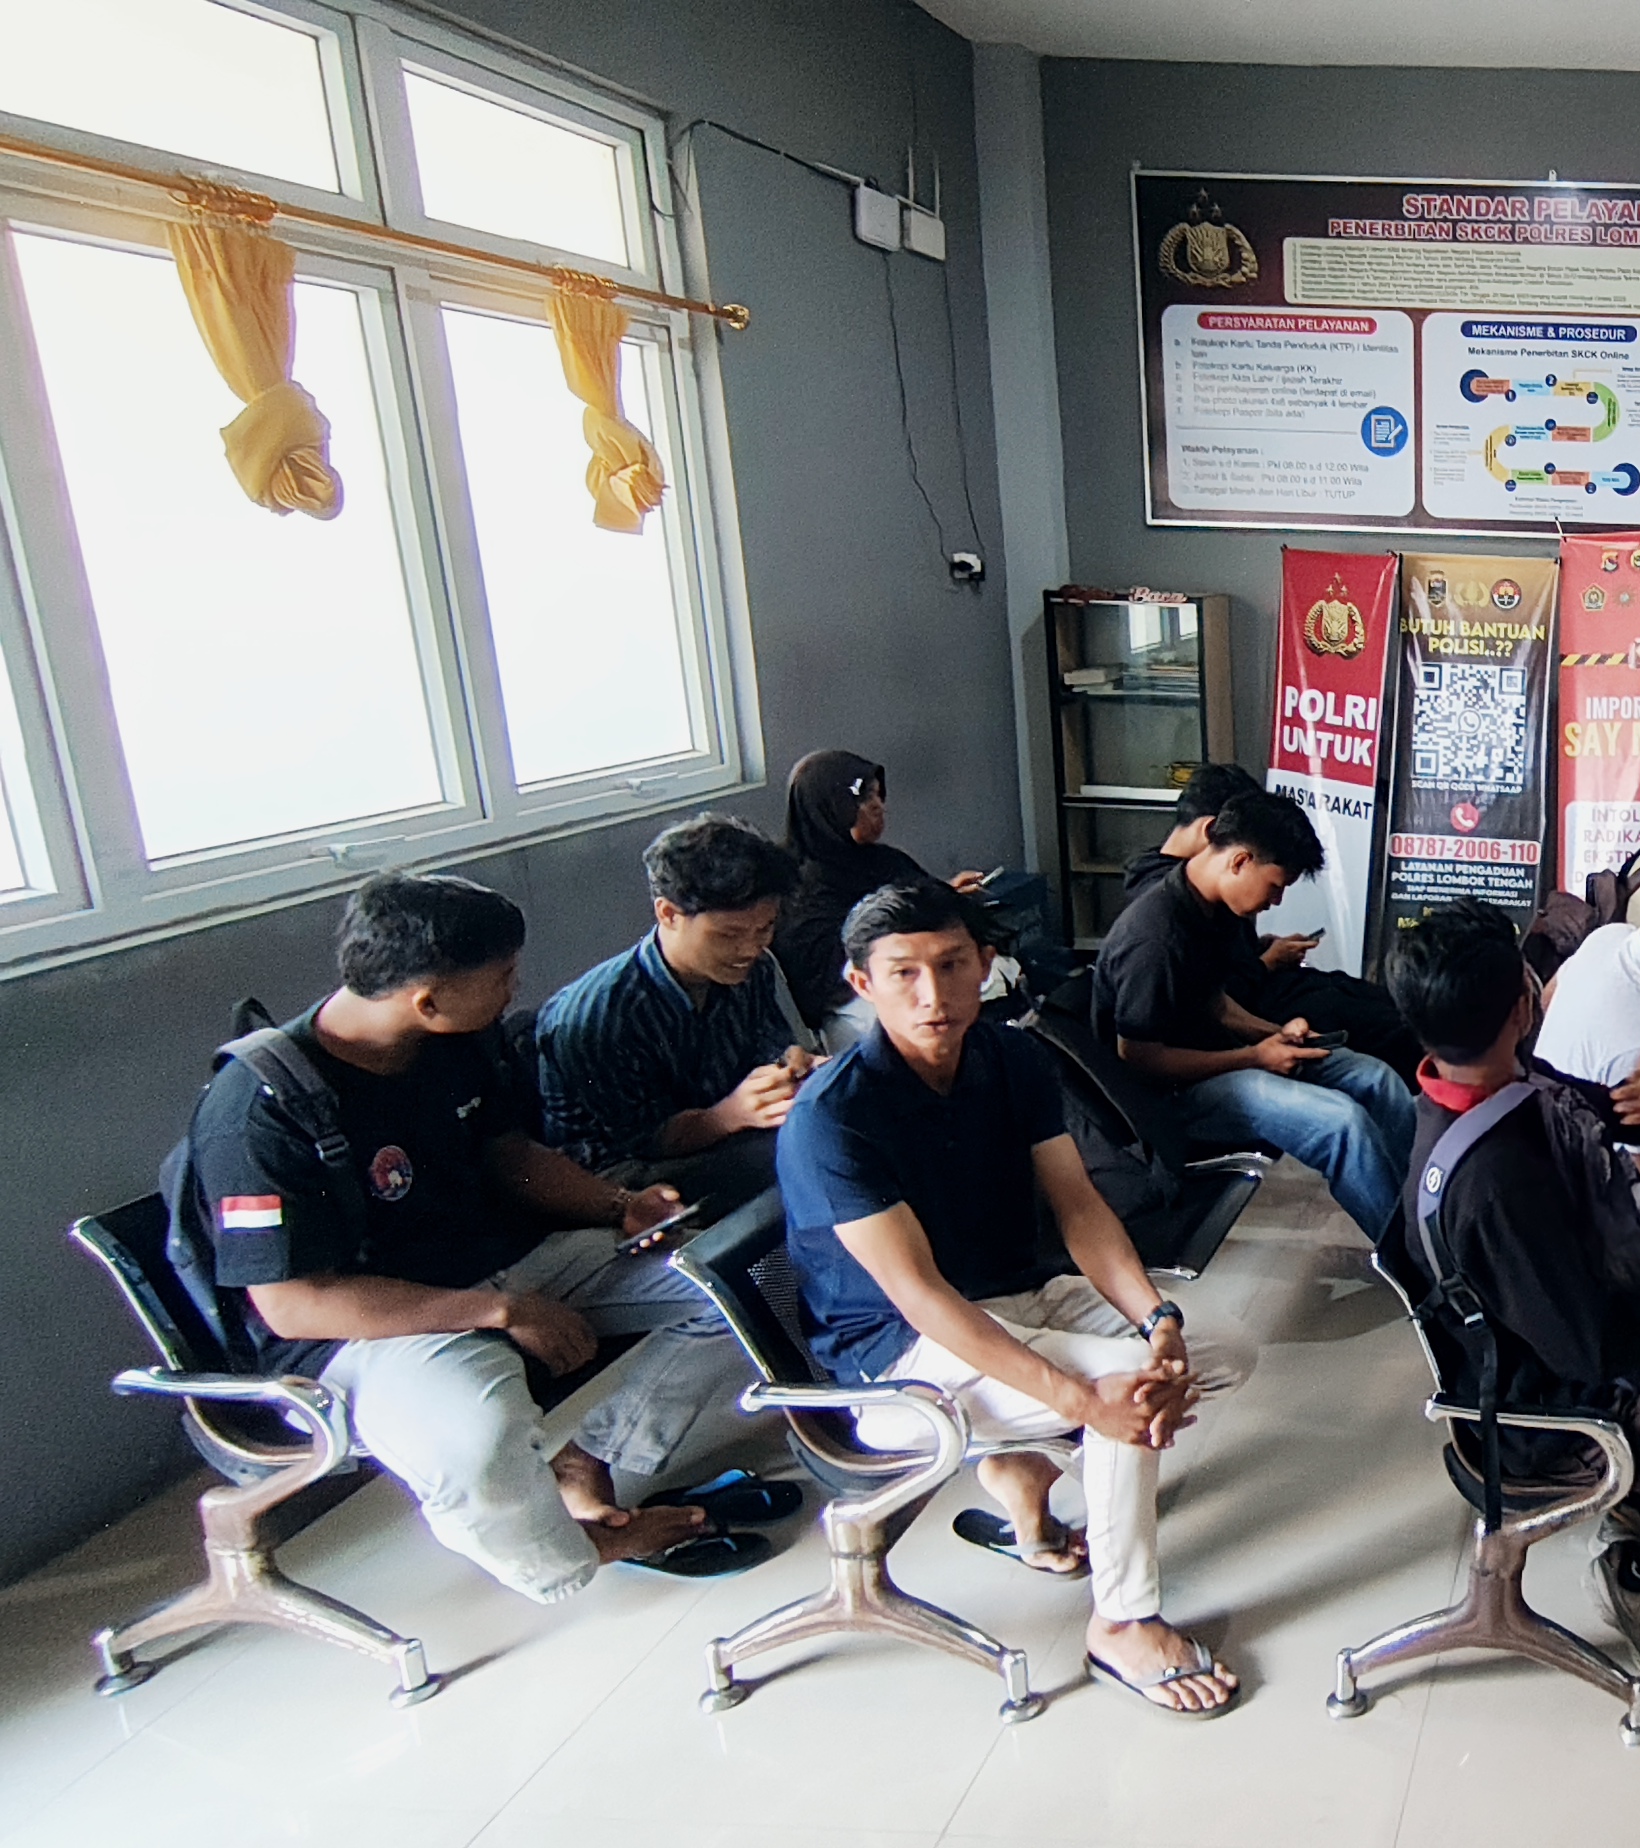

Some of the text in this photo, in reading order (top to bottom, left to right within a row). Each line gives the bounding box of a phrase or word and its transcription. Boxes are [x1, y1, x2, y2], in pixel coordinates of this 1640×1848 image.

[1402, 194, 1530, 220] STANDAR
[1328, 218, 1452, 239] PENERBITAN
[1456, 222, 1513, 242] SKCK
[1515, 224, 1593, 243] POLRES
[1209, 316, 1370, 332] PERSYARATAN PELAYANAN
[1472, 324, 1626, 341] MEKANISME & PROSEDUR
[1468, 347, 1630, 361] Mekanisme Penerbitan SKCK Online
[1400, 618, 1546, 640] BUTUH BANTUAN
[1428, 637, 1514, 657] POLISI..??
[1285, 686, 1378, 731] POLRI
[1283, 725, 1374, 768] UNTUK
[1564, 721, 1623, 757] SAY
[1412, 780, 1435, 789] SCAN
[1391, 835, 1538, 863] 08787-2006-110
[1401, 861, 1525, 878] LAYANAN PENGADUAN
[1391, 872, 1534, 889] POLRES LOMBOK TENGAH
